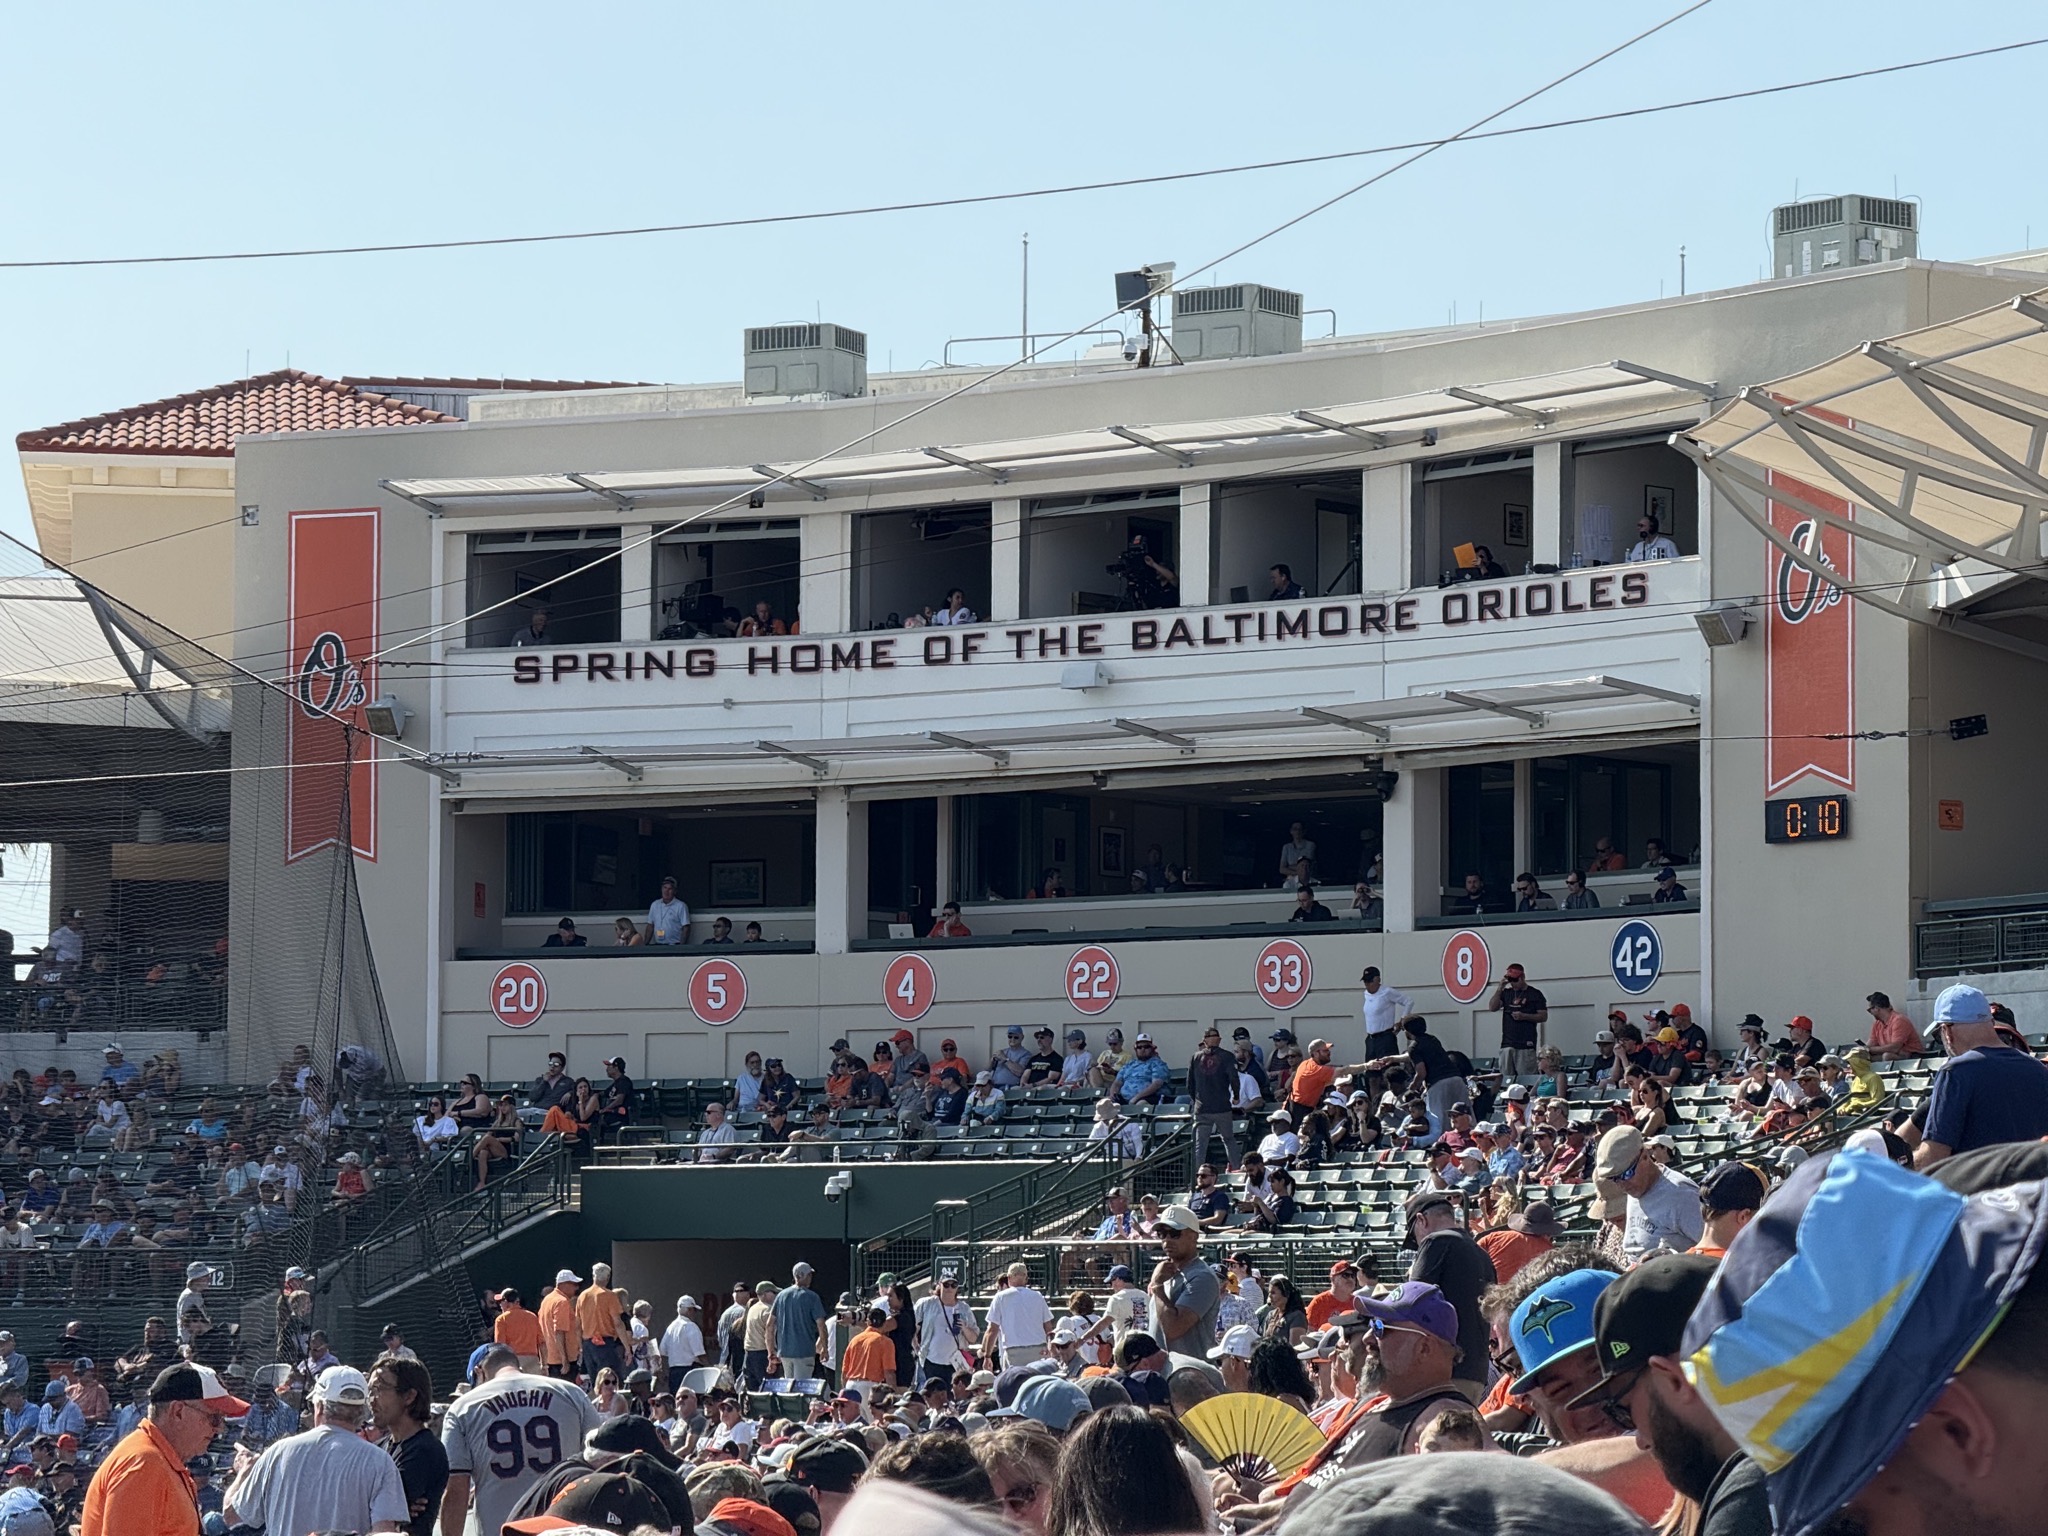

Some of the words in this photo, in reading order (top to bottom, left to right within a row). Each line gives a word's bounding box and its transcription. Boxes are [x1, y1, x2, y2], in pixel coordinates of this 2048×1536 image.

[513, 648, 717, 684] SPRING
[747, 639, 898, 676] HOME
[923, 632, 989, 666] OF
[1005, 622, 1104, 660] THE
[1131, 599, 1419, 652] BALTIMORE
[1442, 571, 1650, 626] ORIOLES
[1786, 800, 1840, 838] 0:10
[1263, 954, 1303, 994] 33
[1456, 947, 1474, 987] 8
[1615, 936, 1654, 978] 42
[499, 977, 539, 1013] 20
[706, 973, 727, 1010] 5
[897, 968, 916, 1005] 4
[1072, 961, 1111, 999] 22
[208, 1270, 225, 1286] 12
[484, 1390, 553, 1415] VAUGHN
[487, 1416, 562, 1479] 99
